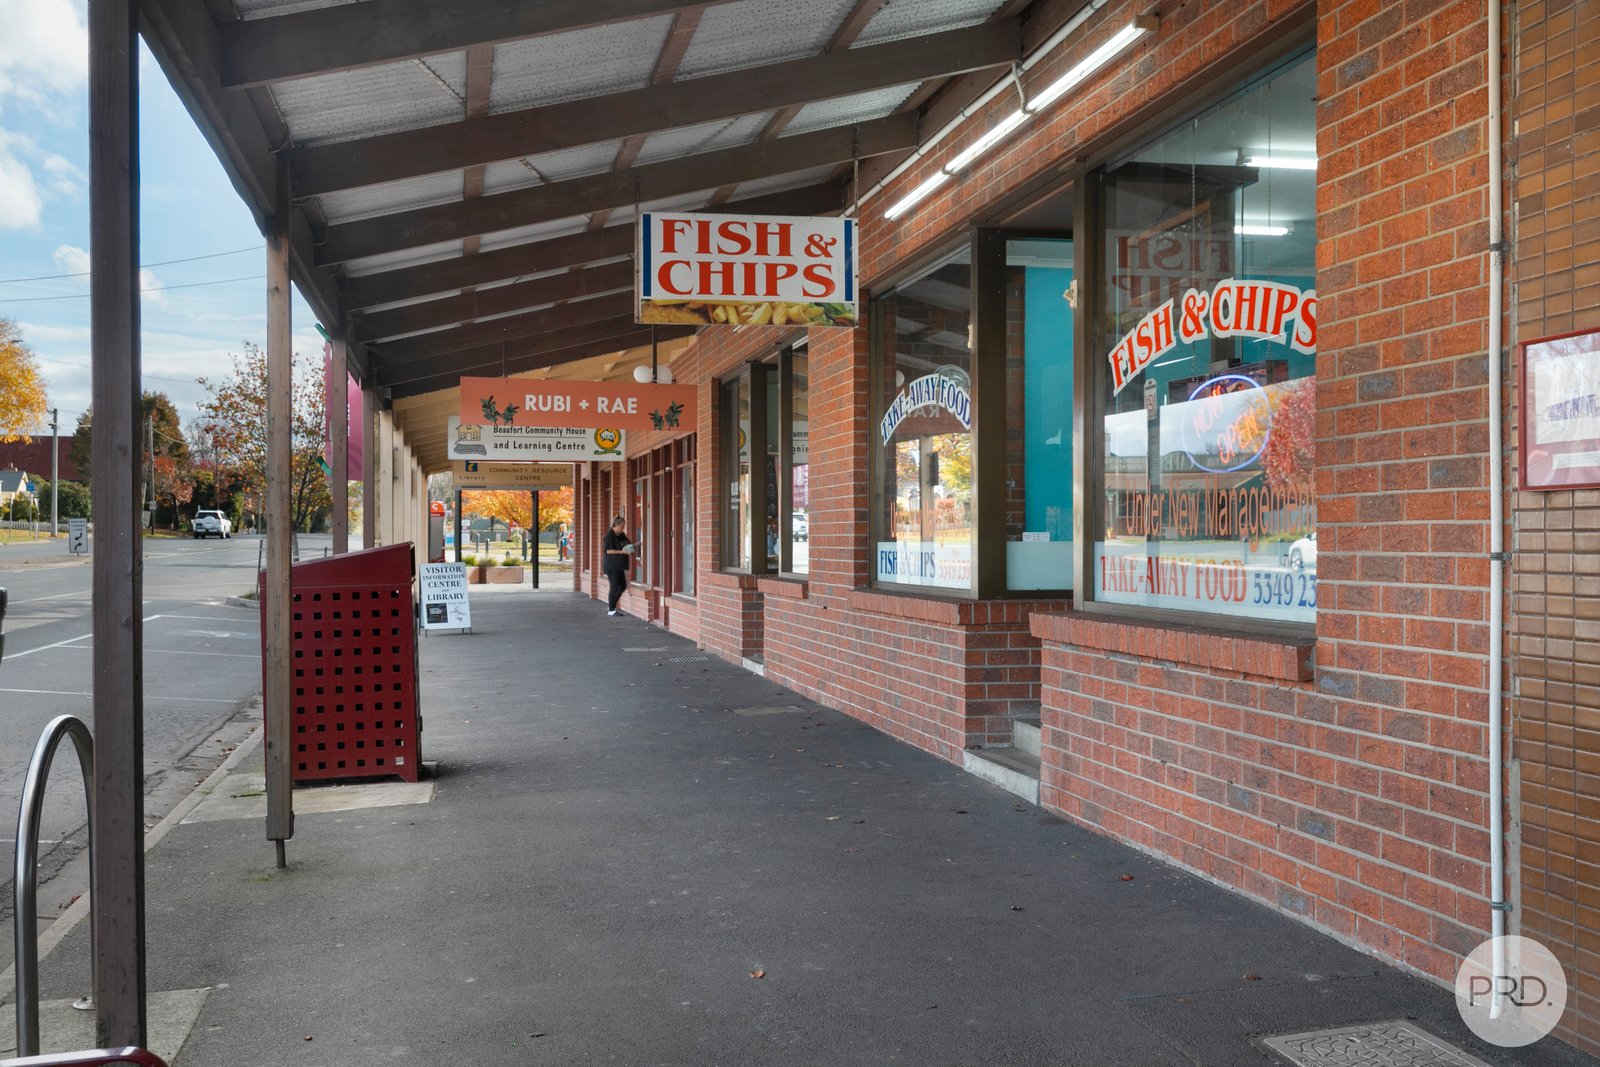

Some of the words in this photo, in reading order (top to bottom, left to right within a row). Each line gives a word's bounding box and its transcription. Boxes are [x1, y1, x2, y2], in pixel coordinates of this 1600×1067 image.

[660, 219, 794, 257] FISH
[803, 233, 838, 258] &
[657, 259, 837, 298] CHIPS
[1111, 304, 1174, 389] FISH
[1181, 294, 1207, 339] &
[1212, 285, 1317, 348] CHIPS
[525, 394, 571, 412] RUBI
[597, 397, 638, 414] RAE
[882, 376, 938, 442] TAKE-AWAY
[939, 379, 971, 426] FOOD
[493, 425, 523, 435] Beaufort
[525, 426, 563, 437] Community
[565, 427, 586, 435] House
[493, 441, 509, 450] and
[513, 441, 552, 452] Learning
[555, 442, 586, 451] Centre
[1126, 480, 1165, 536] Under
[1168, 477, 1200, 537] New
[1205, 472, 1317, 552] Management
[425, 566, 462, 574] VISITOR
[880, 550, 898, 575] FISH
[428, 580, 462, 588] CENTRE
[1101, 555, 1190, 598] TAKE-AWAY
[1195, 558, 1247, 603] FOOD
[1253, 573, 1294, 606] 5349
[1297, 574, 1317, 608] 23
[427, 592, 465, 601] LIBRARY
